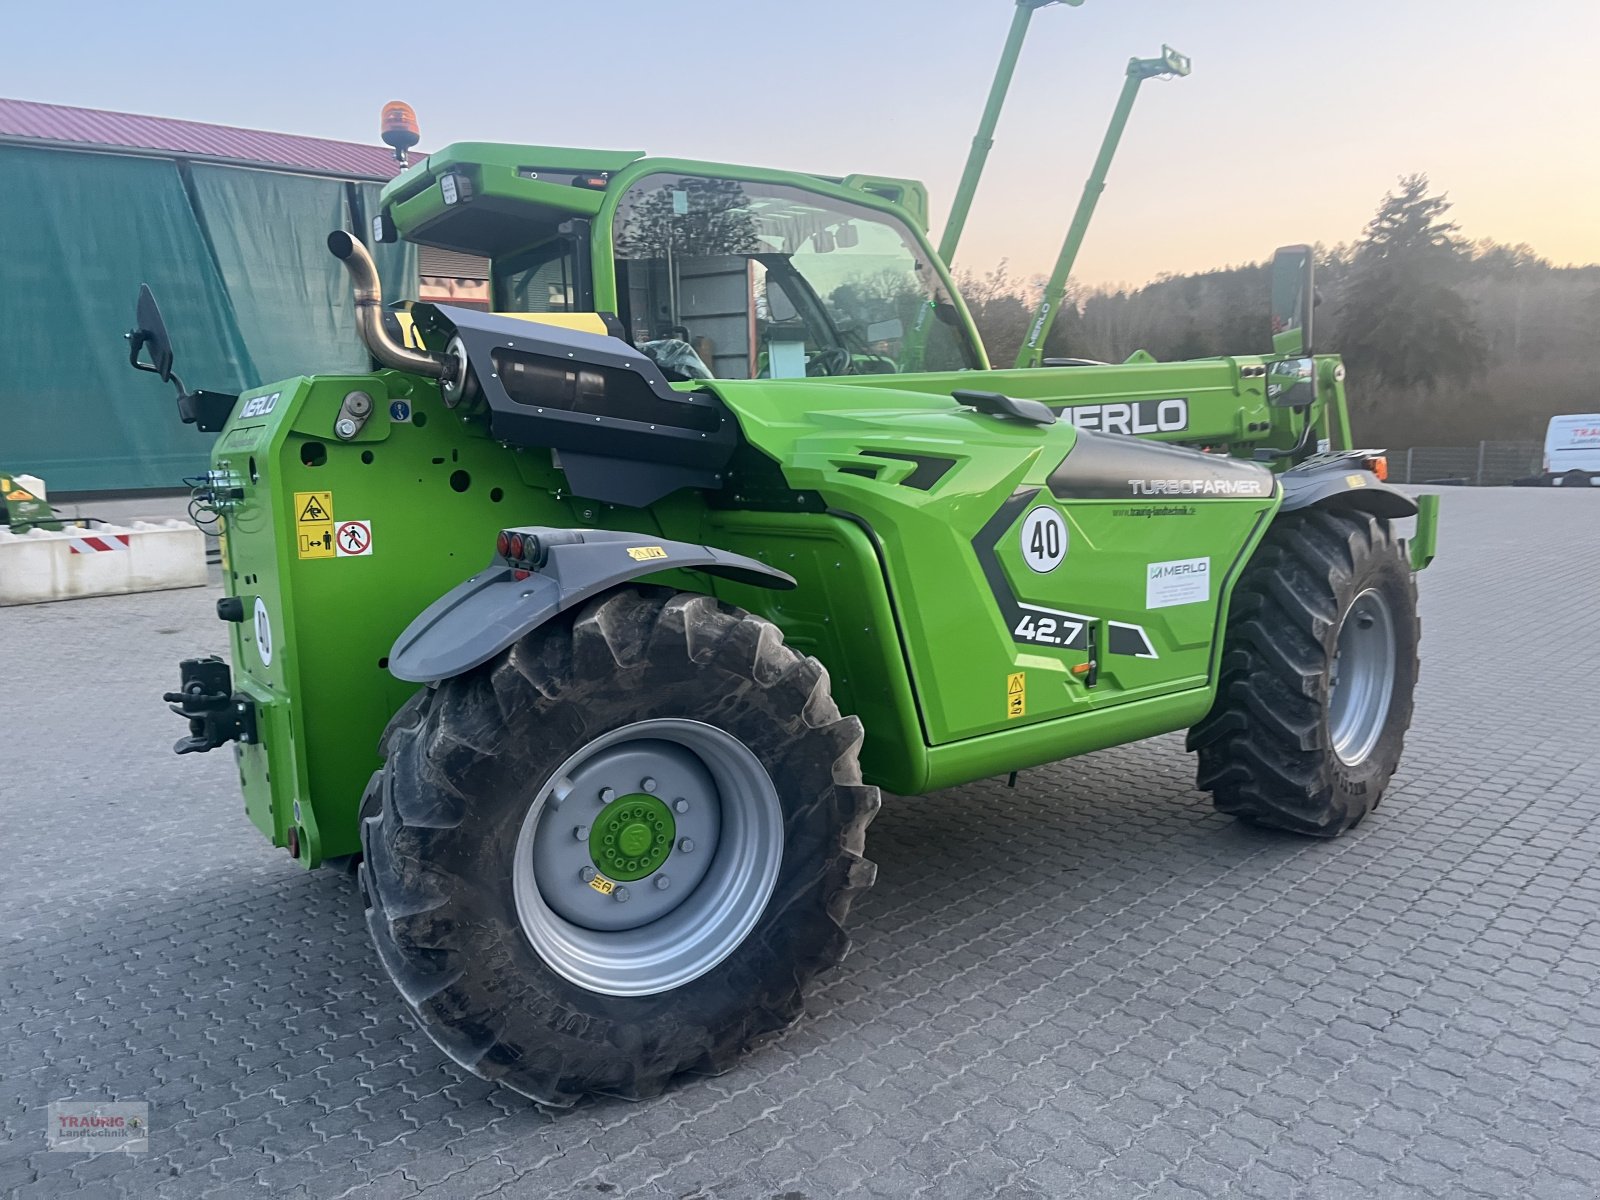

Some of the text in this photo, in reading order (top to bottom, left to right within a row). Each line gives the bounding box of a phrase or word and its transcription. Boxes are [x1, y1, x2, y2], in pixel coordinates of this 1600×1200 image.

[1028, 303, 1051, 347] MERLO
[1127, 480, 1262, 495] TURBOFARMER
[1031, 519, 1060, 559] 40
[1163, 562, 1207, 576] MERLO
[1014, 615, 1084, 645] 42.7
